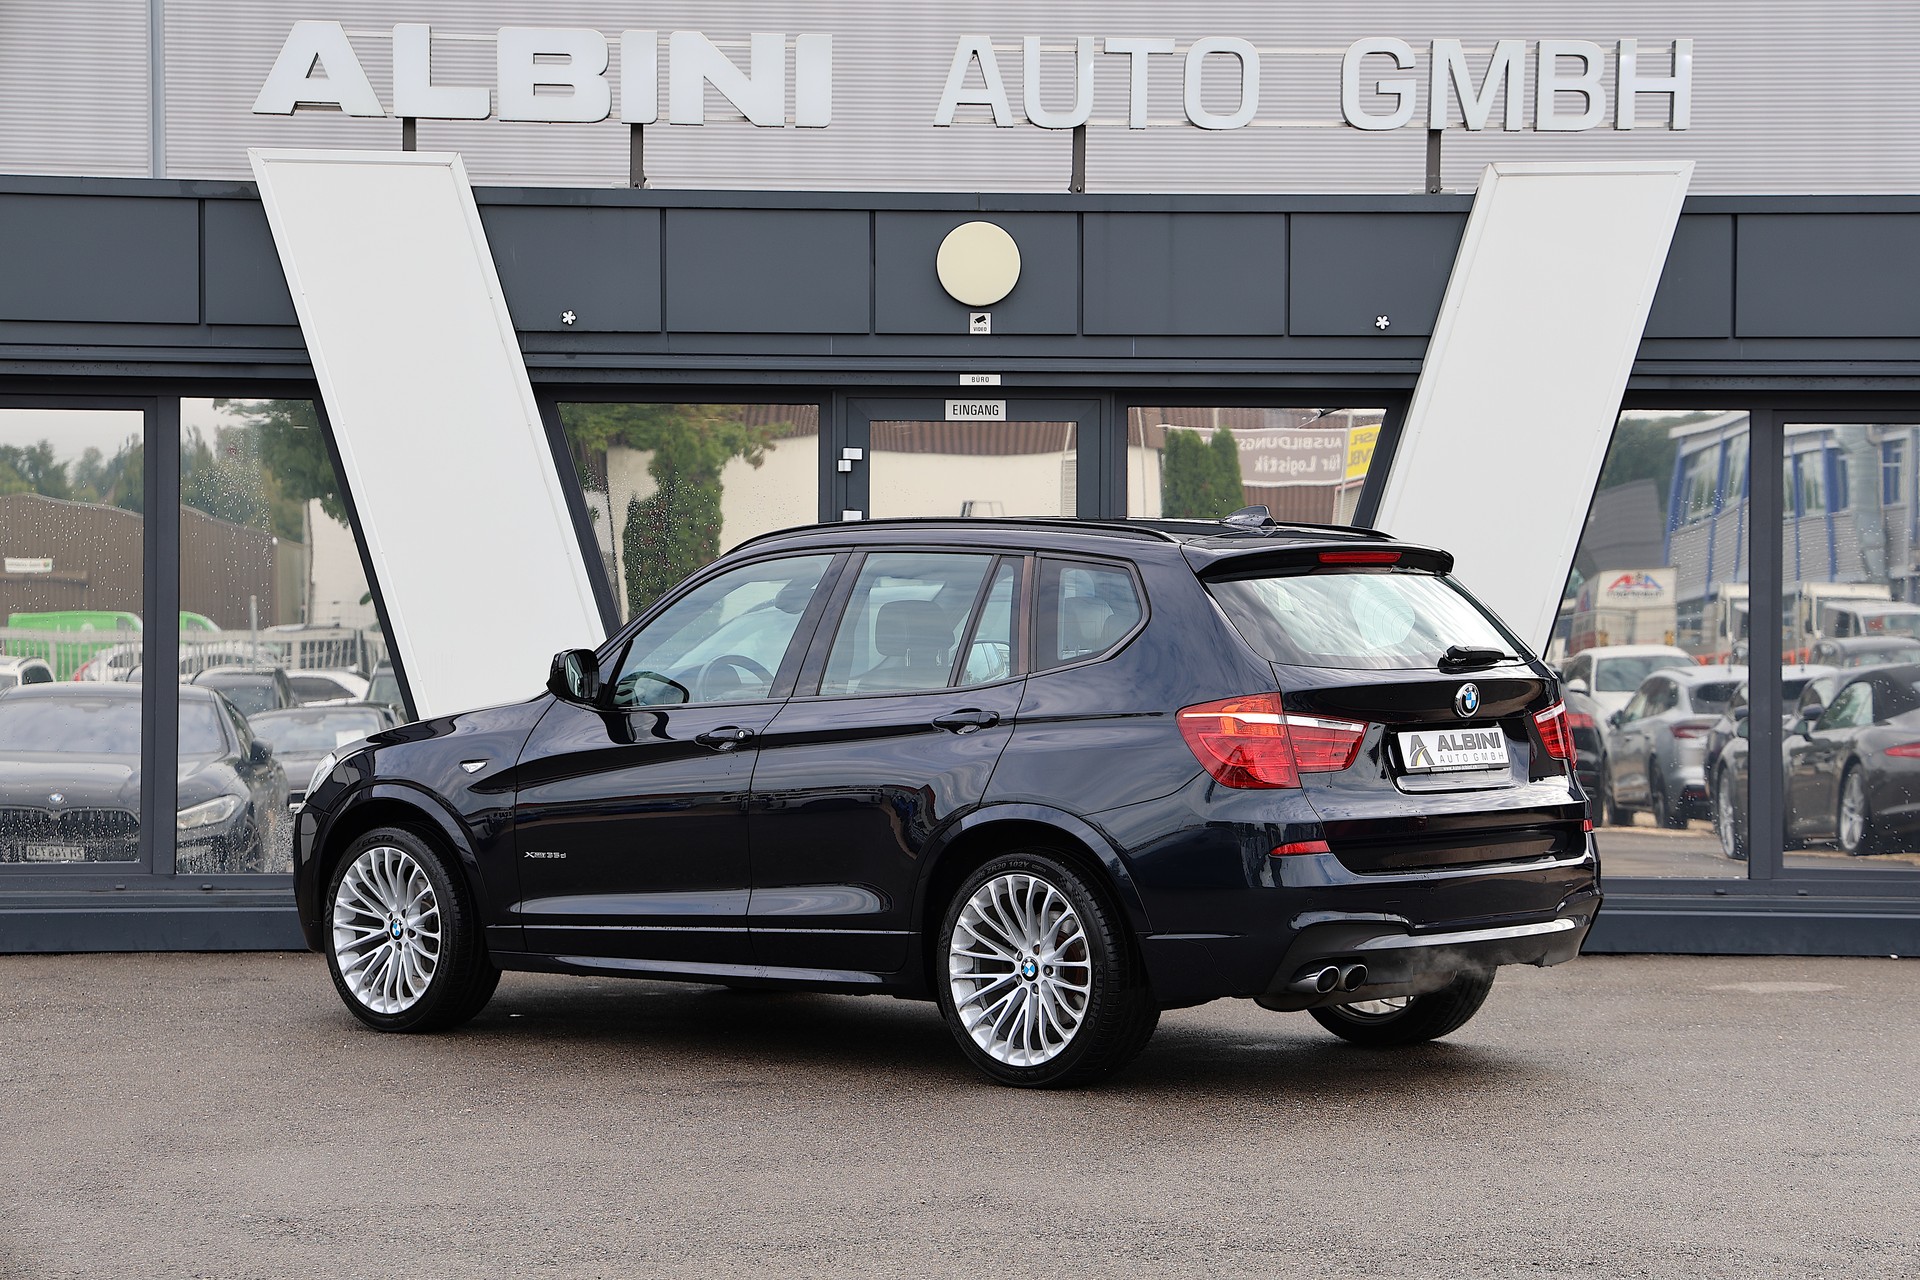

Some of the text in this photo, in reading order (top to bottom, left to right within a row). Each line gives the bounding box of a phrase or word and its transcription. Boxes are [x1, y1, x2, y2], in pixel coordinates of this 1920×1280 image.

[252, 19, 1694, 132] ALBINI AUTO GMBH
[971, 375, 990, 383] BÜRO
[952, 404, 999, 416] EINGANG
[1437, 731, 1502, 752] ALBINI
[1440, 751, 1505, 764] AUTO GMBH
[1086, 960, 1105, 1032] KUMHO
